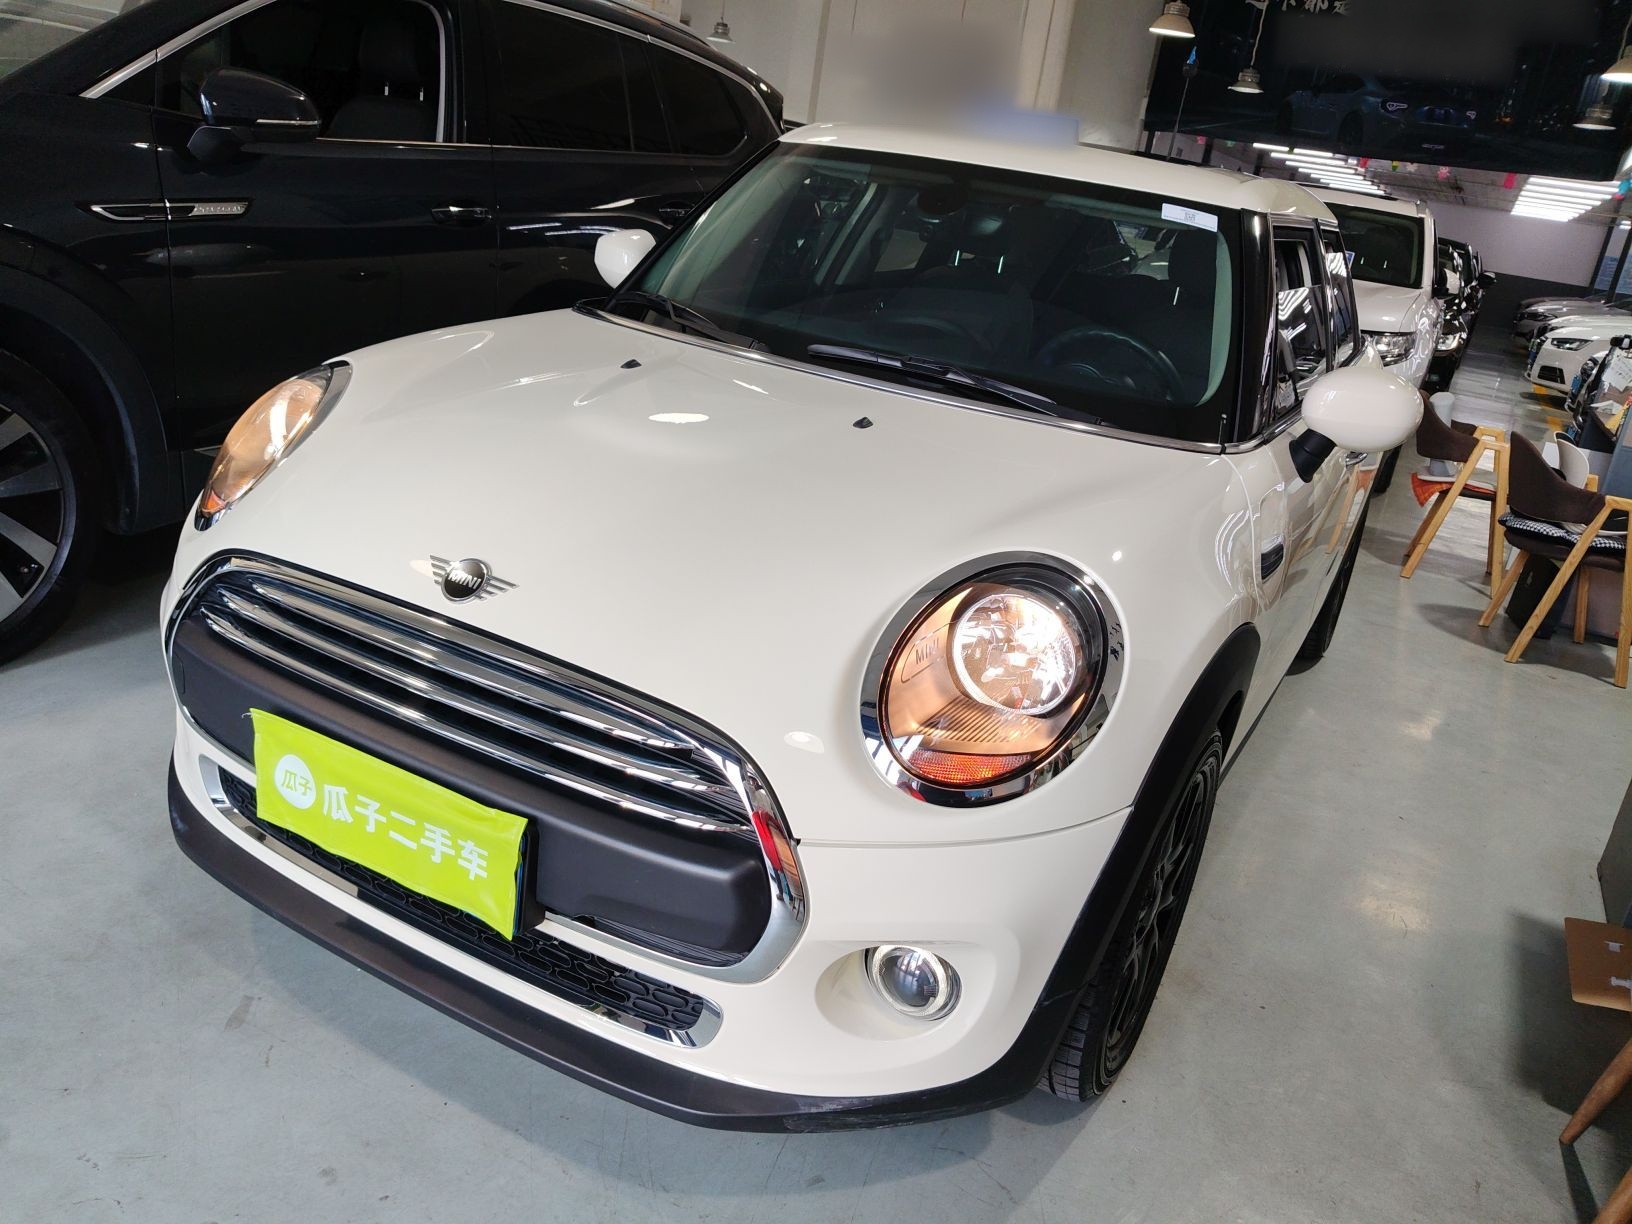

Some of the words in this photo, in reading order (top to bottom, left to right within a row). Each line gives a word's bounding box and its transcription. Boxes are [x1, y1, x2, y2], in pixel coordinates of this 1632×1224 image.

[448, 569, 482, 590] MINI
[281, 769, 313, 796] 瓜子
[323, 783, 489, 881] 瓜子二手车
